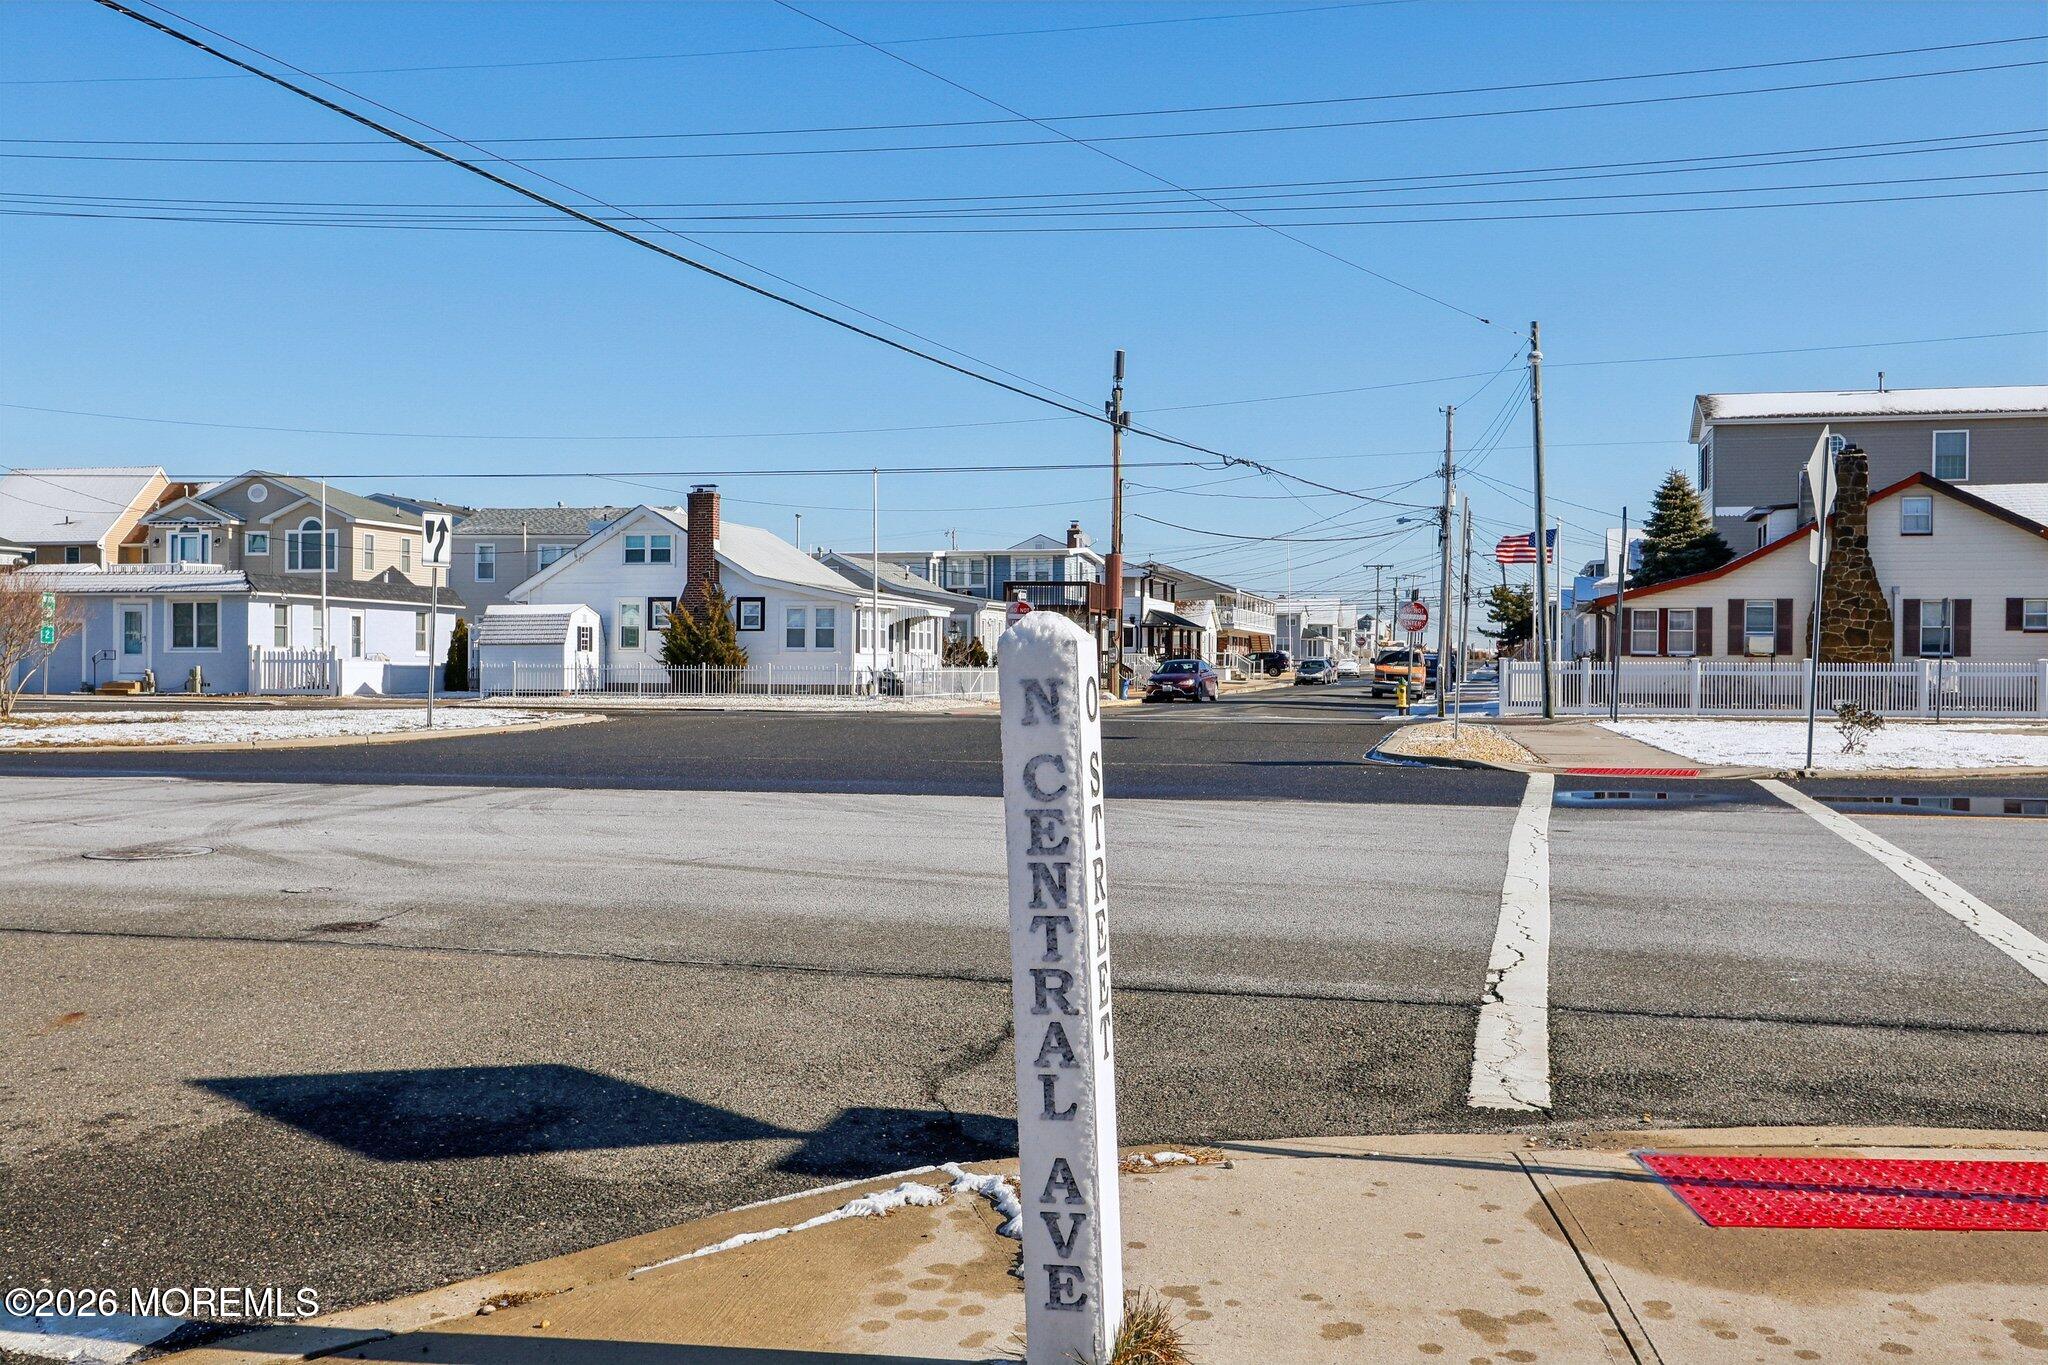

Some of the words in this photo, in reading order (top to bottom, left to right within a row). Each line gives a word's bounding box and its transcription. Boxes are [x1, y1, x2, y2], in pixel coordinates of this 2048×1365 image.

[45, 629, 50, 638] 2
[1018, 677, 1065, 727] N
[1085, 675, 1098, 722] O
[1022, 753, 1080, 1121] CENTRAL
[1090, 751, 1112, 1061] STREET
[1039, 1157, 1087, 1311] AVE
